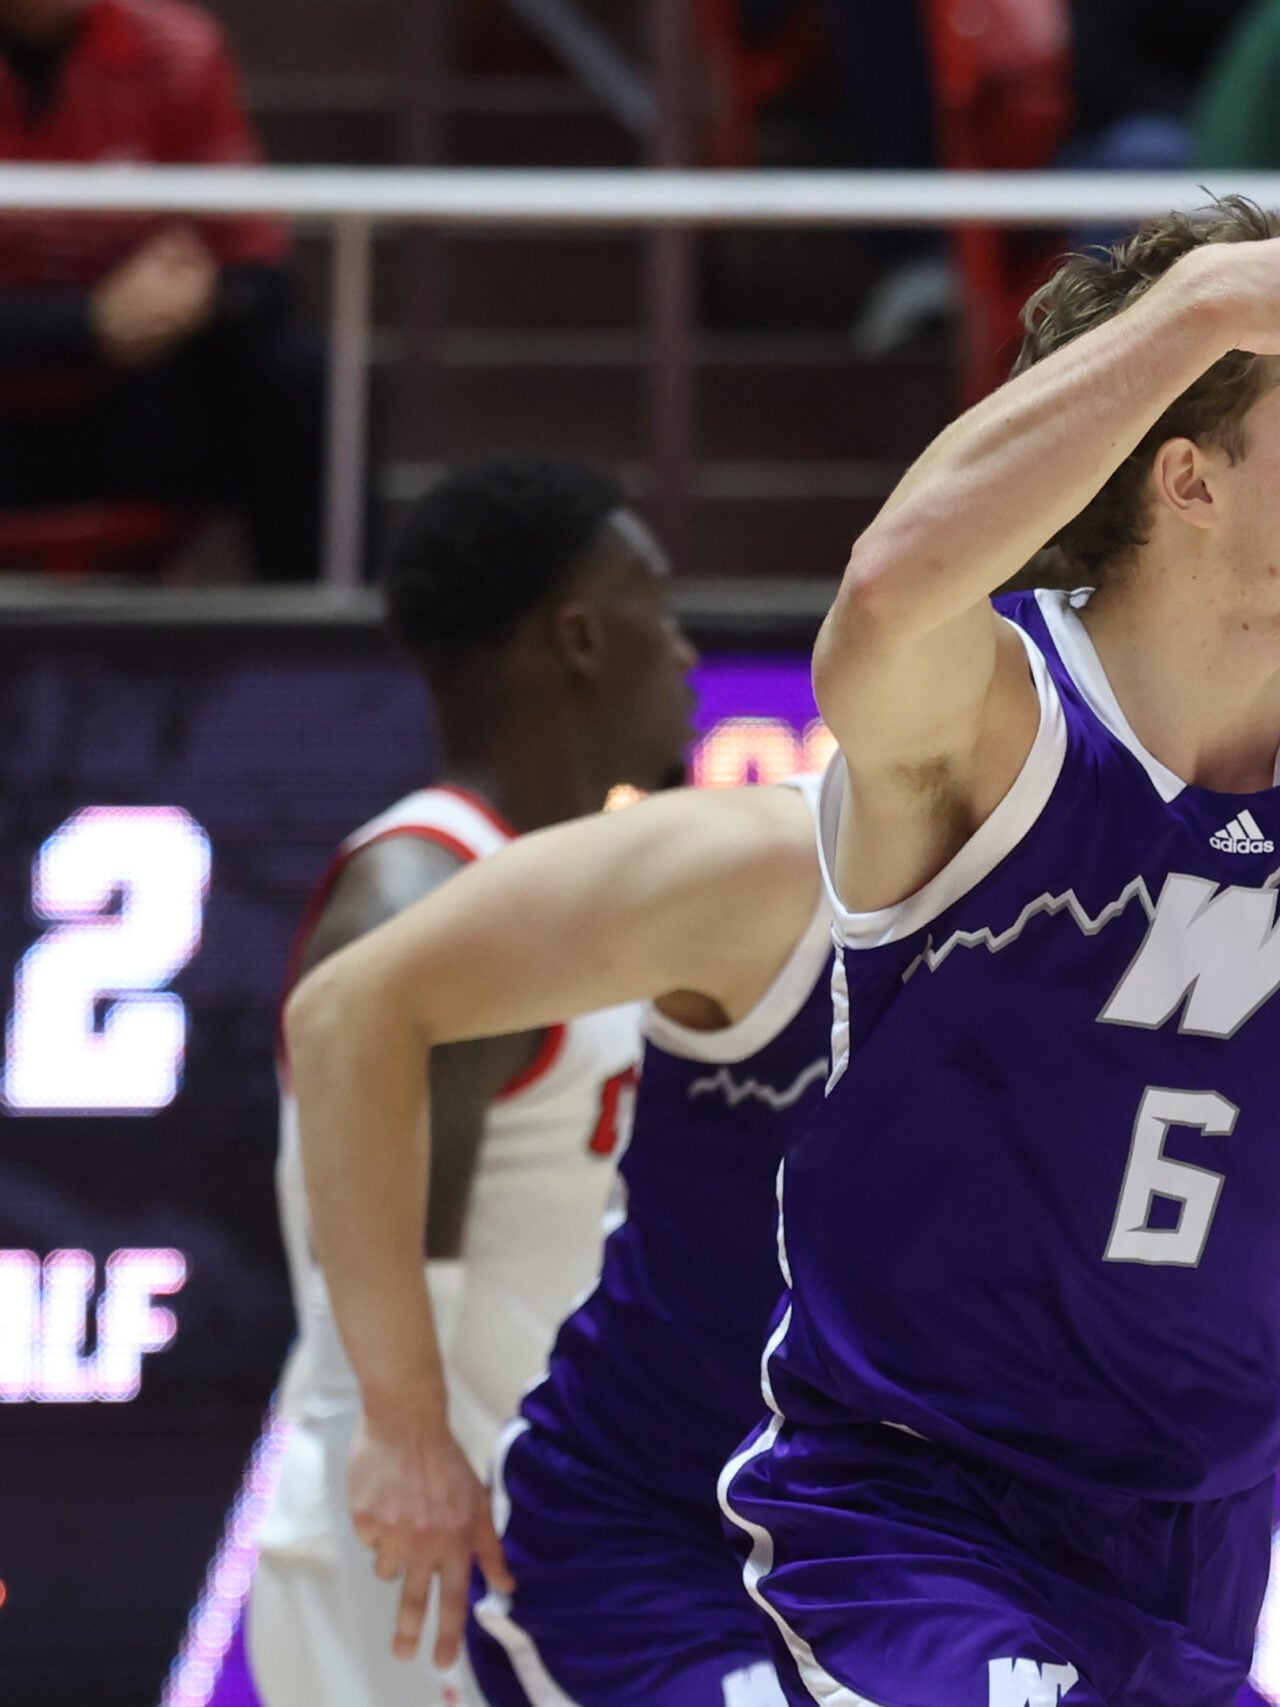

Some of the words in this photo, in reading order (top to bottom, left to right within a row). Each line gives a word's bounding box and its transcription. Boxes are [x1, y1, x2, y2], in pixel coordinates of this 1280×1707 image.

[1208, 836, 1275, 854] adidas
[3, 806, 211, 1117] 2
[1102, 1085, 1240, 1268] 6
